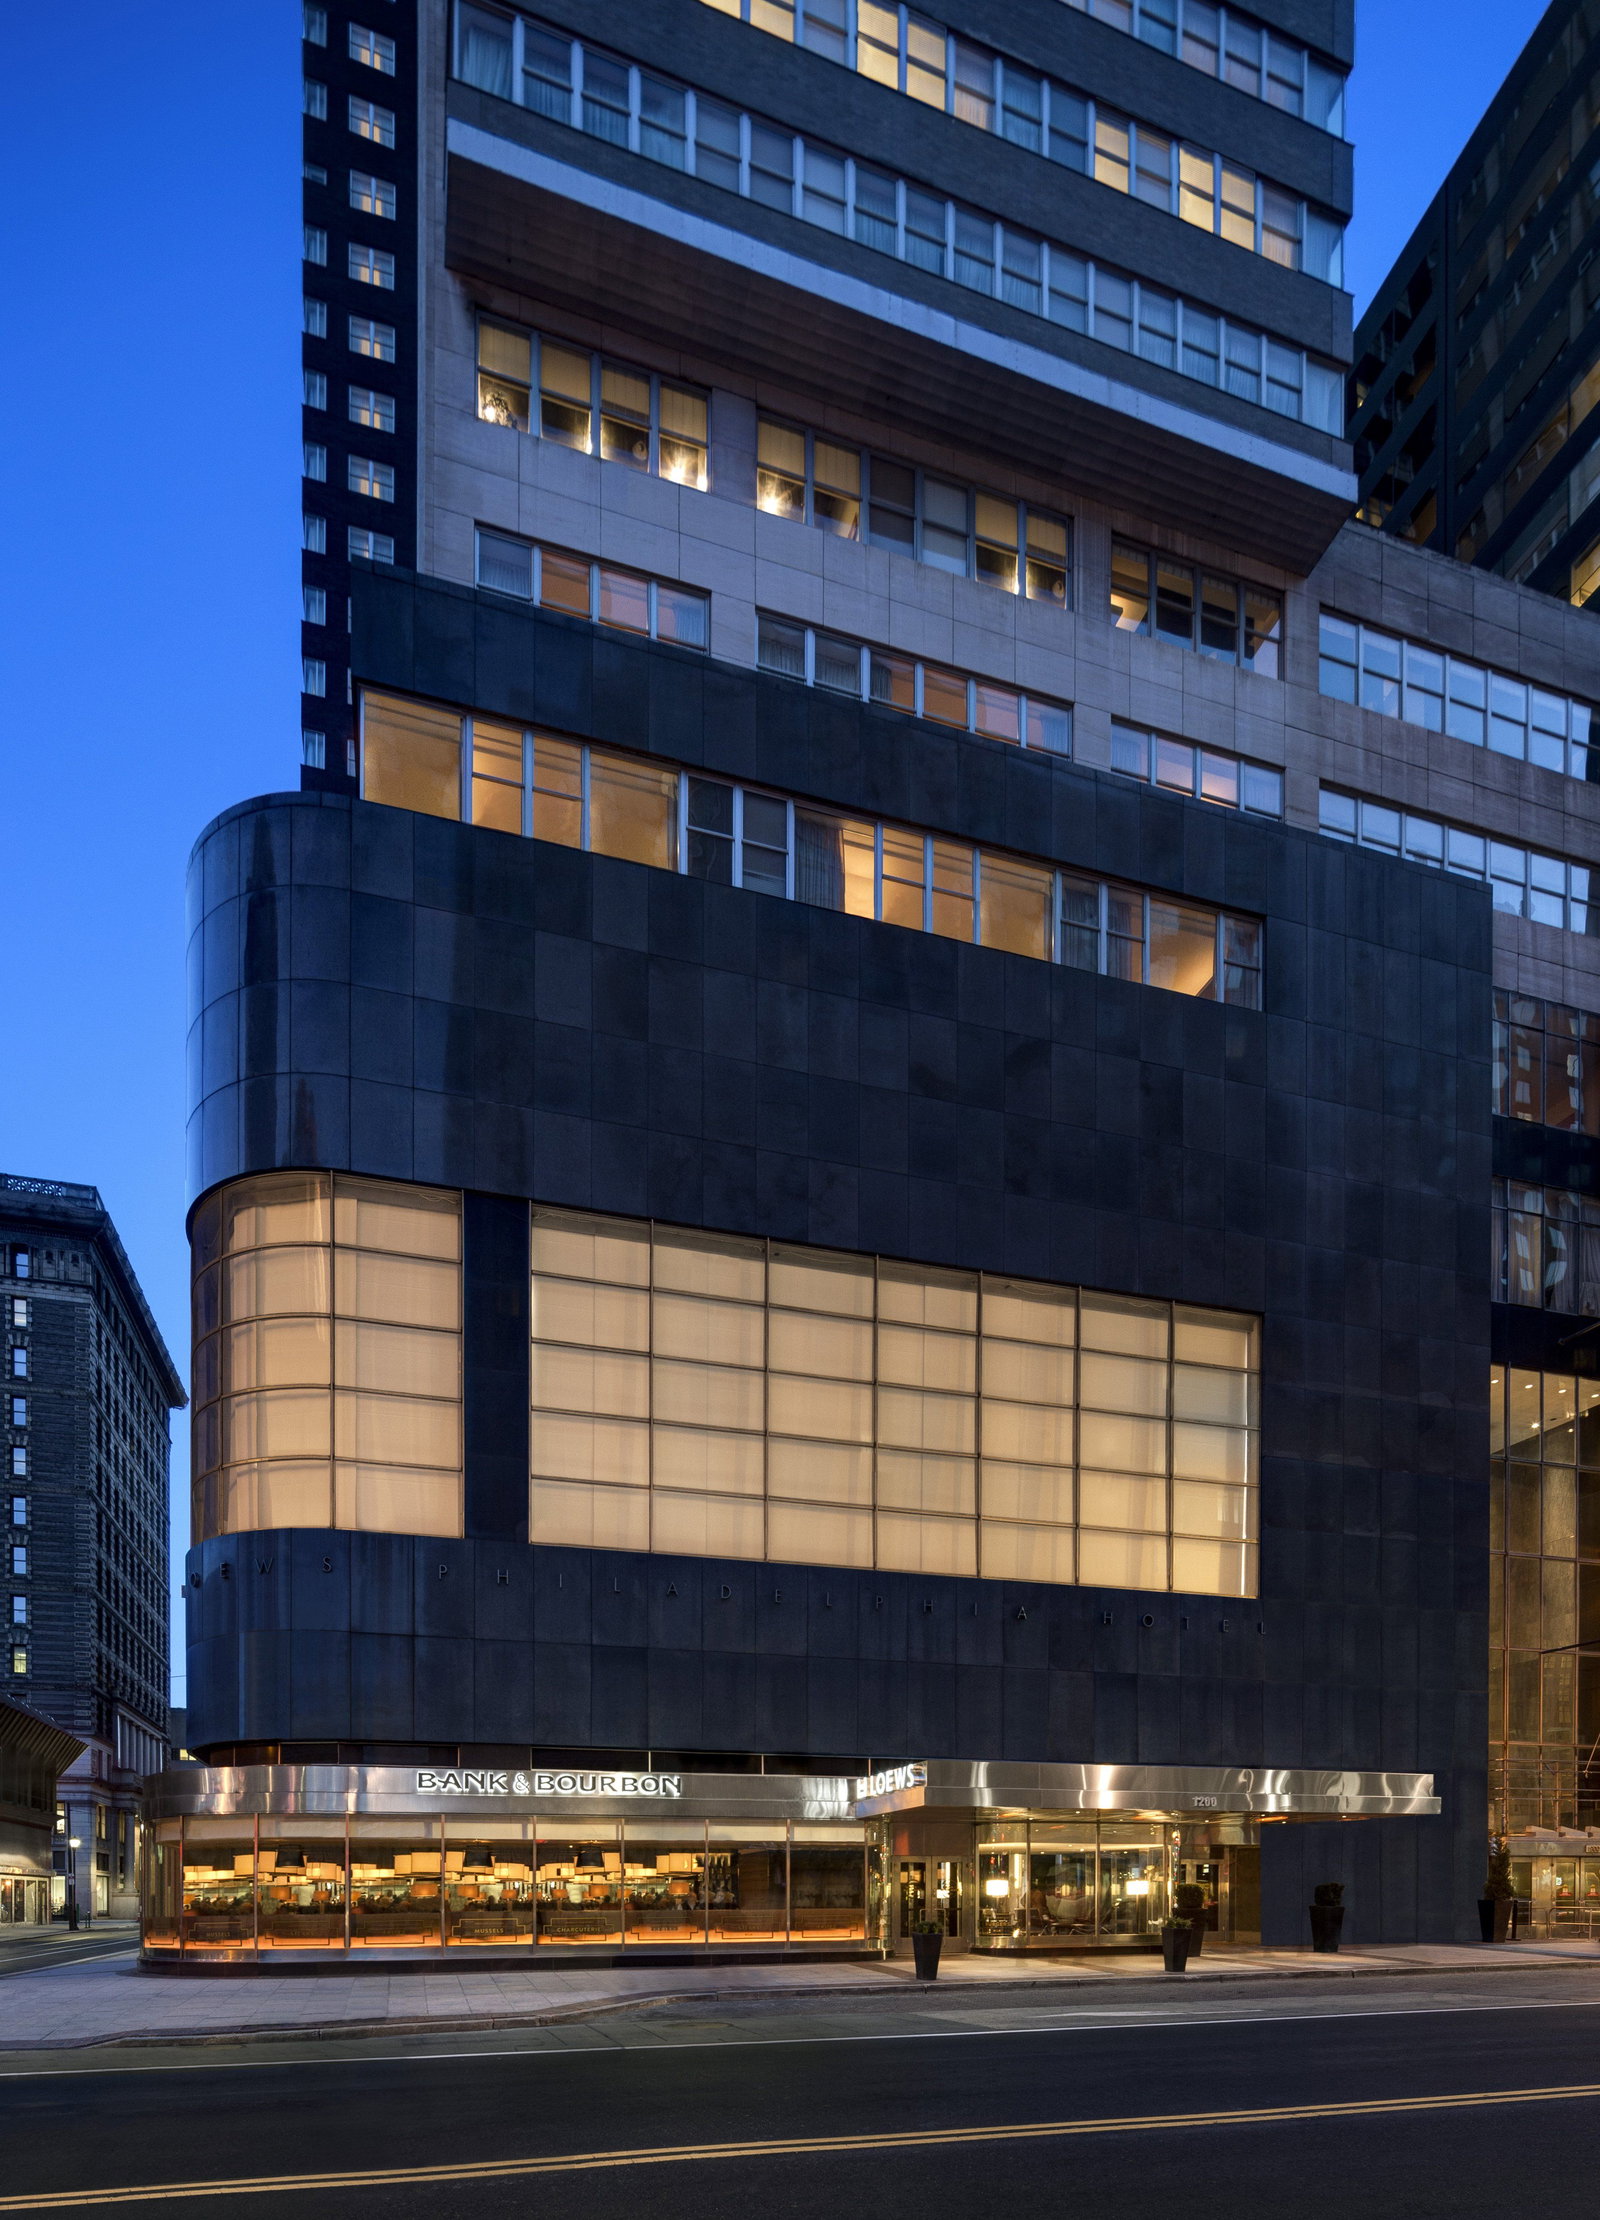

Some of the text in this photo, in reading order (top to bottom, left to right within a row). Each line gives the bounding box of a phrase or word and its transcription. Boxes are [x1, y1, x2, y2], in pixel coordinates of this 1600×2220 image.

[182, 1556, 1267, 1636] OEWS PHILADELPHIA HOTEL
[417, 1772, 682, 1796] BANK & BOURBON
[869, 1764, 915, 1796] LOEWS
[1193, 1796, 1217, 1806] 1200
